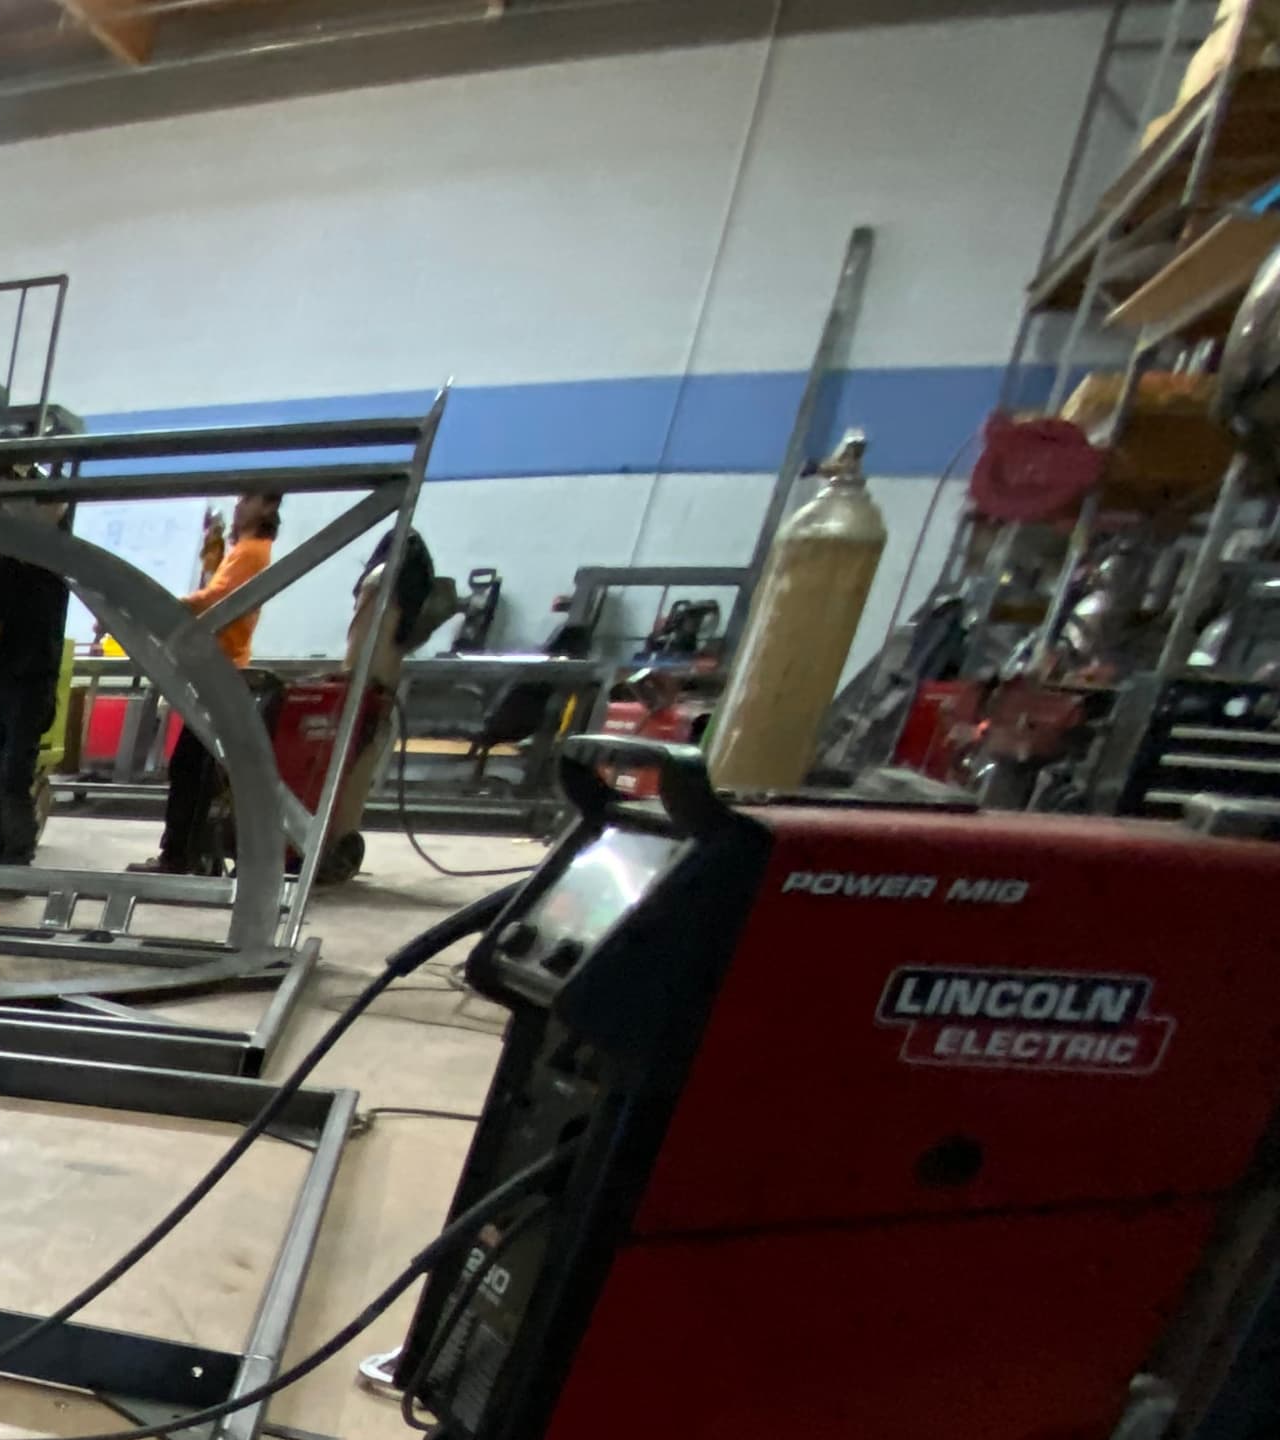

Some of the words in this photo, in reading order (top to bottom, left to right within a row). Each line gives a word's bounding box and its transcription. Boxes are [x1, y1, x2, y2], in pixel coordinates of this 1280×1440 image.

[781, 871, 938, 898] POWER
[945, 877, 1030, 904] MIG
[894, 976, 1132, 1023] LINCOLN
[933, 1026, 1138, 1063] ELECTRIC
